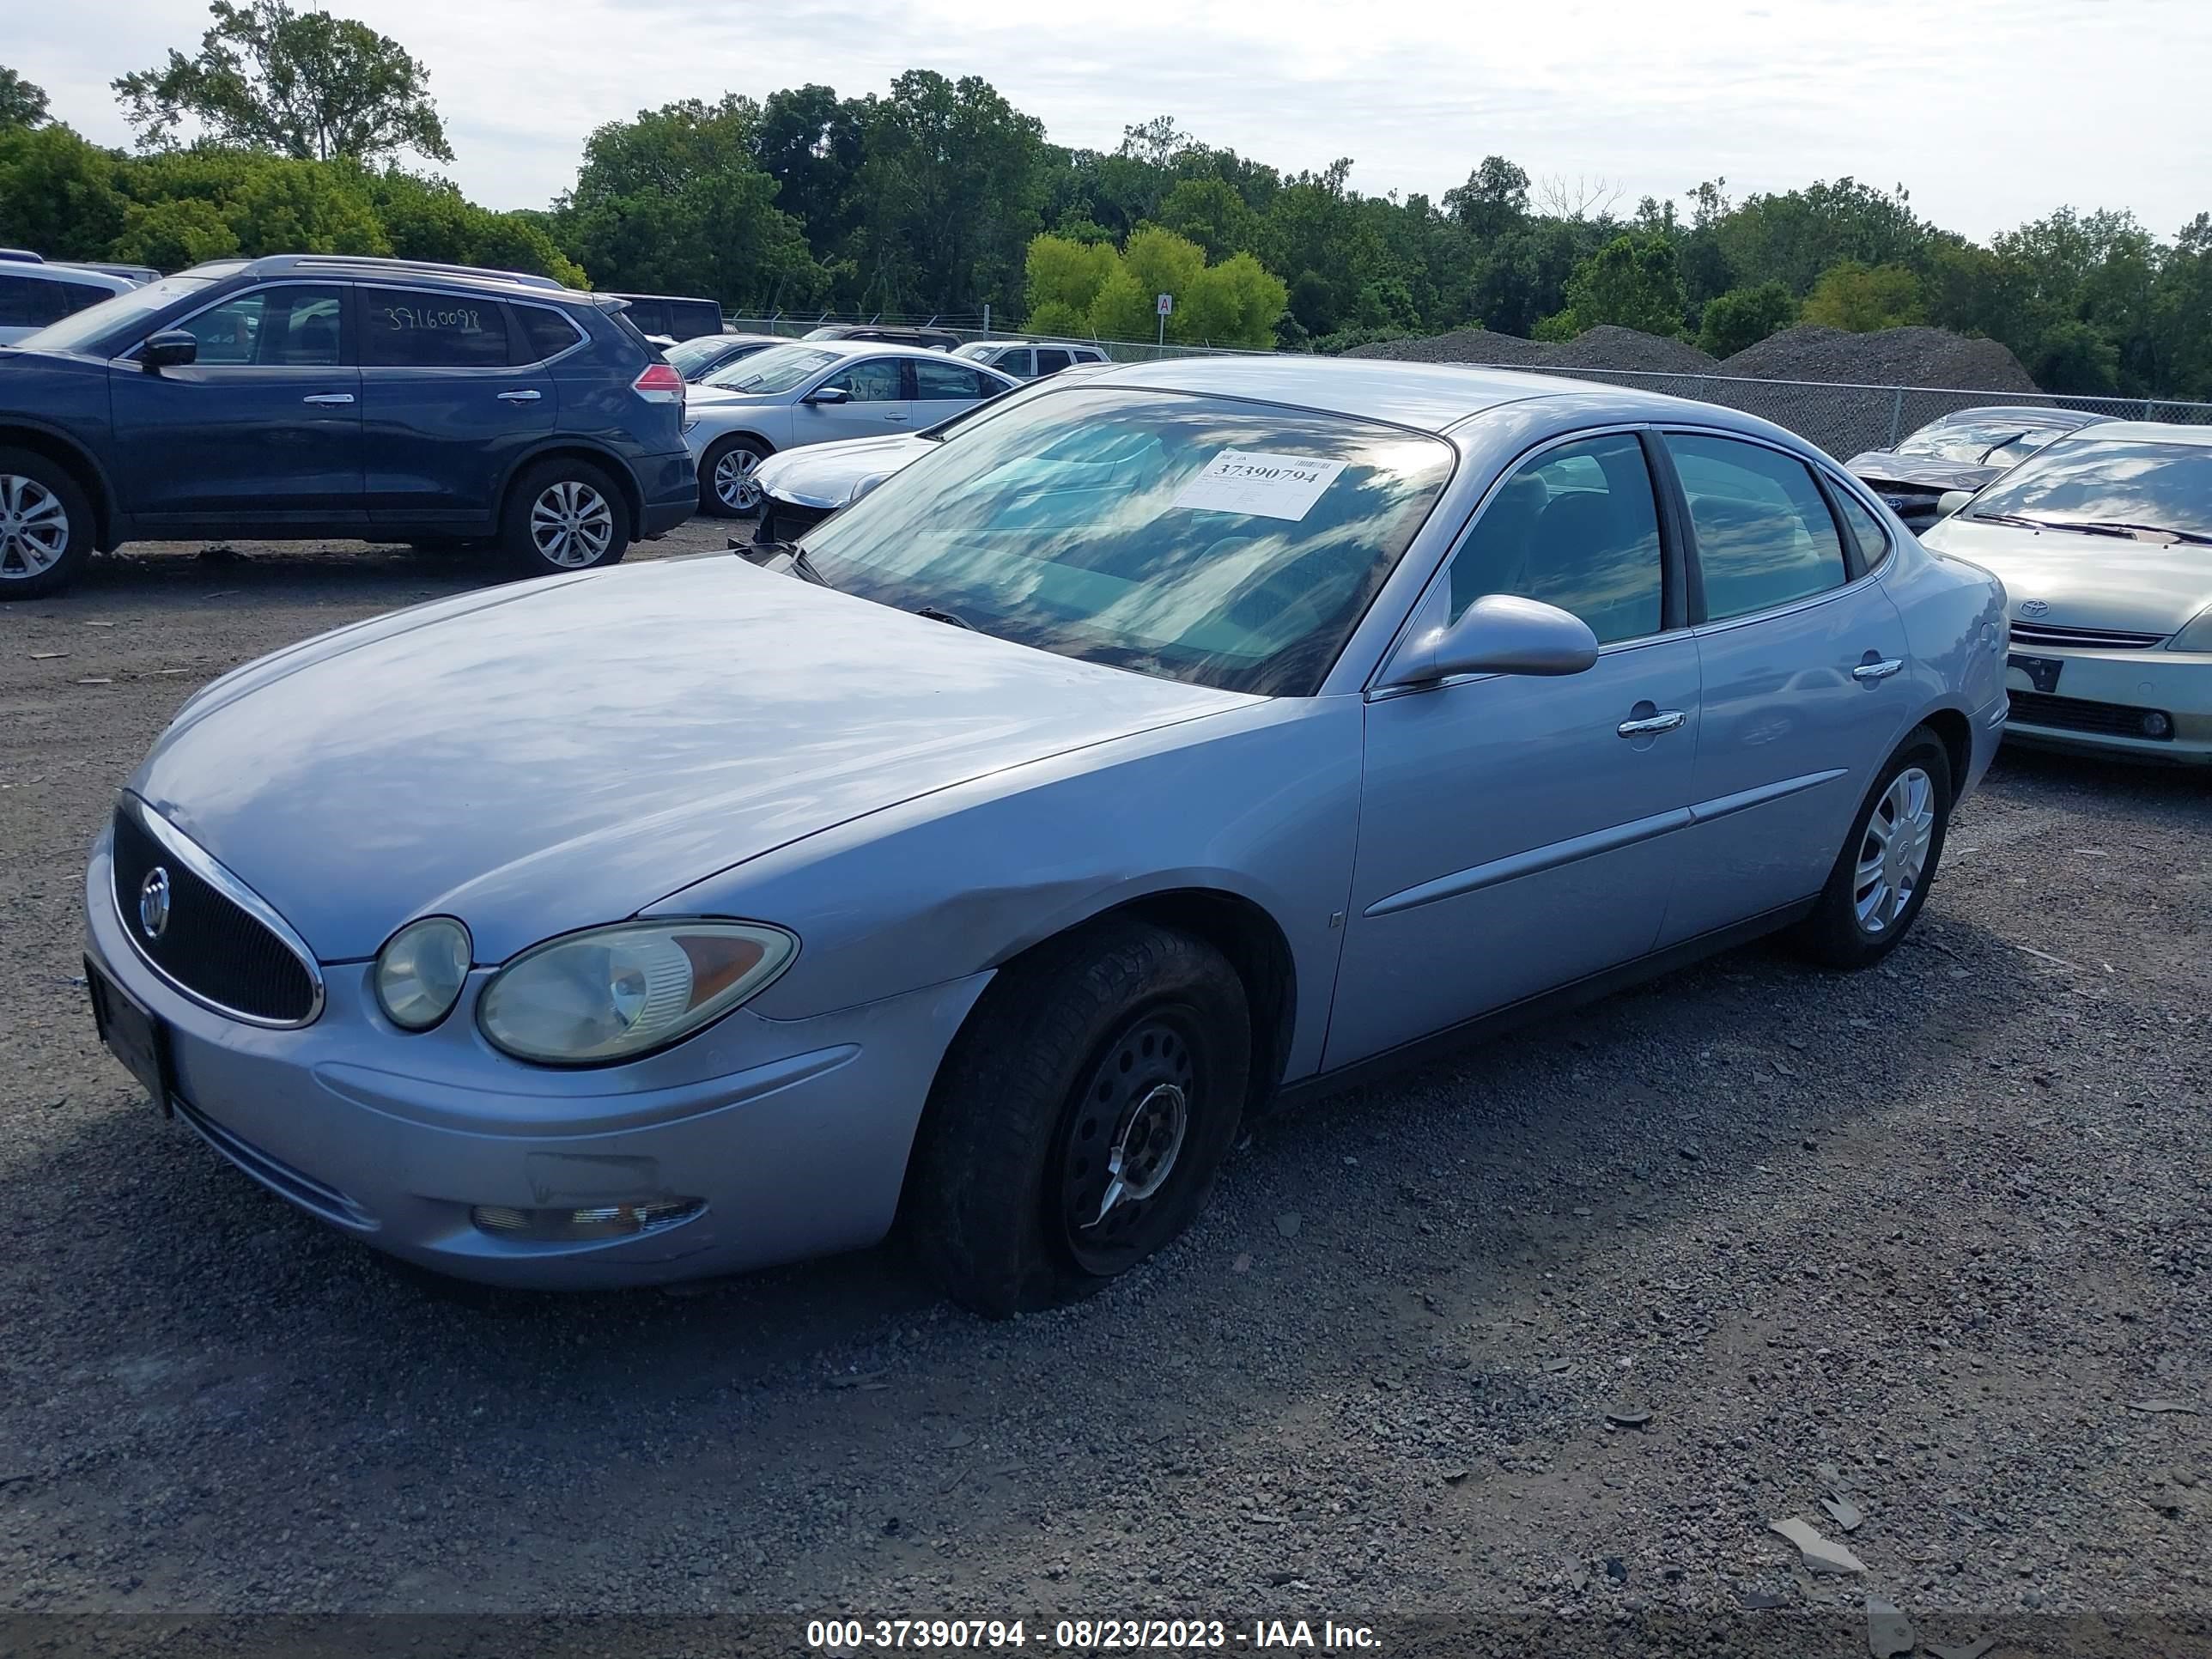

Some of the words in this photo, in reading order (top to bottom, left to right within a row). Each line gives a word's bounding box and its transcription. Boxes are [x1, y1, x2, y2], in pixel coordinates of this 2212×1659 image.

[1160, 298, 1169, 311] A
[385, 307, 480, 331] 37160098
[1213, 464, 1320, 483] 37390794
